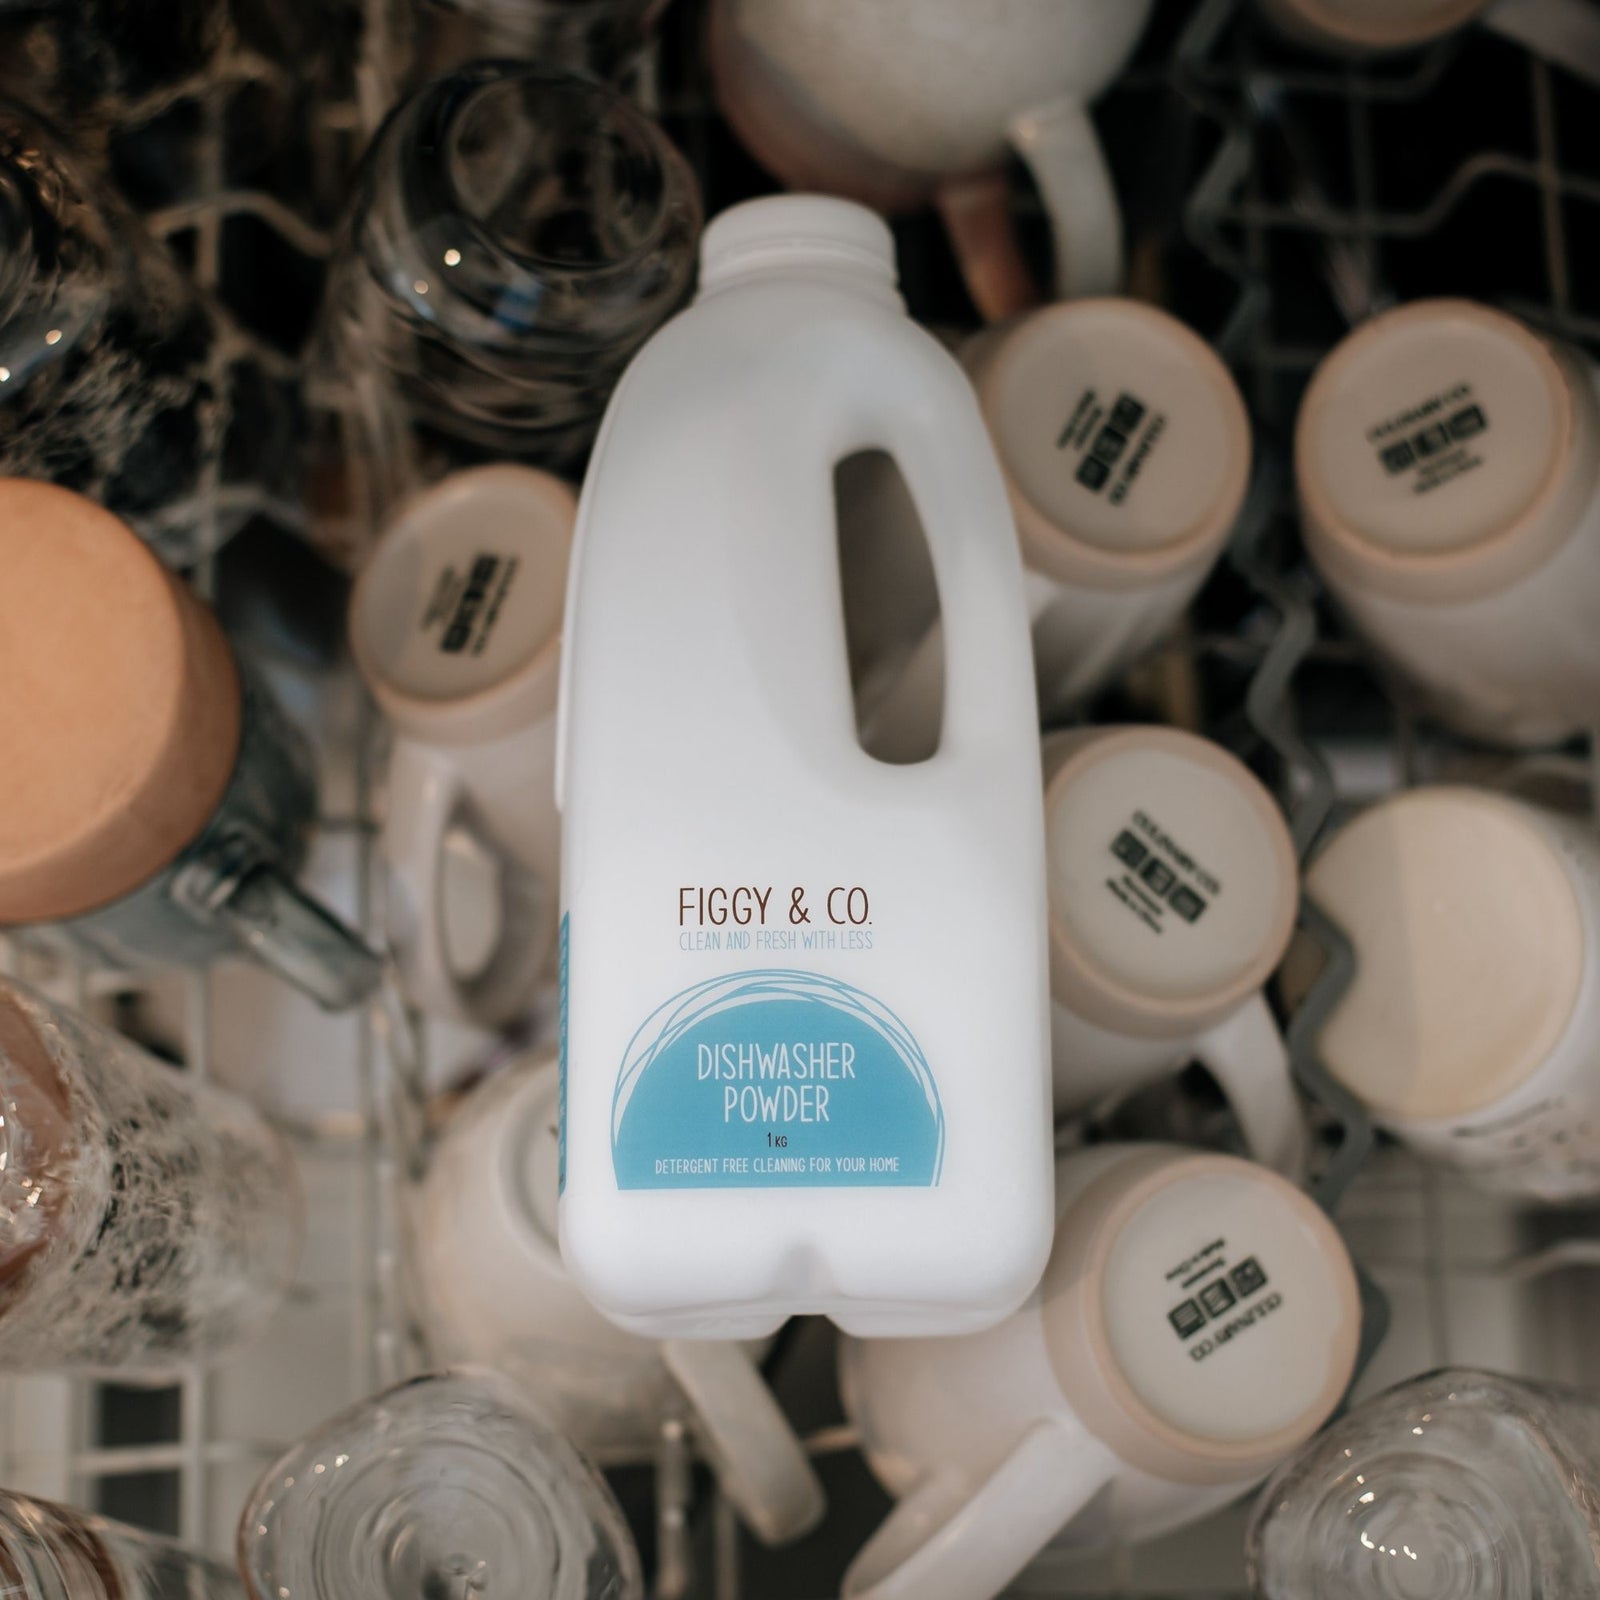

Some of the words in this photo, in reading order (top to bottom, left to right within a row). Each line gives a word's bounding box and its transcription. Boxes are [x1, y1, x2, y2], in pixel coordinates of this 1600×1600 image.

[679, 886, 773, 926] FIGGY
[788, 886, 811, 925] &
[826, 886, 873, 925] CO.
[679, 931, 721, 951] CLEAN
[726, 931, 751, 950] AND
[756, 930, 796, 950] FRESH
[801, 930, 836, 950] WITH
[840, 930, 873, 950] LESS
[697, 1042, 856, 1081] DISHWASHER
[724, 1085, 830, 1123] POWDER
[767, 1132, 772, 1148] 1
[775, 1136, 788, 1148] KG
[655, 1158, 719, 1175] DETERGENT
[723, 1157, 749, 1173] FREE
[753, 1157, 806, 1173] CLEANING
[809, 1157, 832, 1172] FOR
[835, 1157, 866, 1172] YOUR
[869, 1157, 900, 1172] HOME
